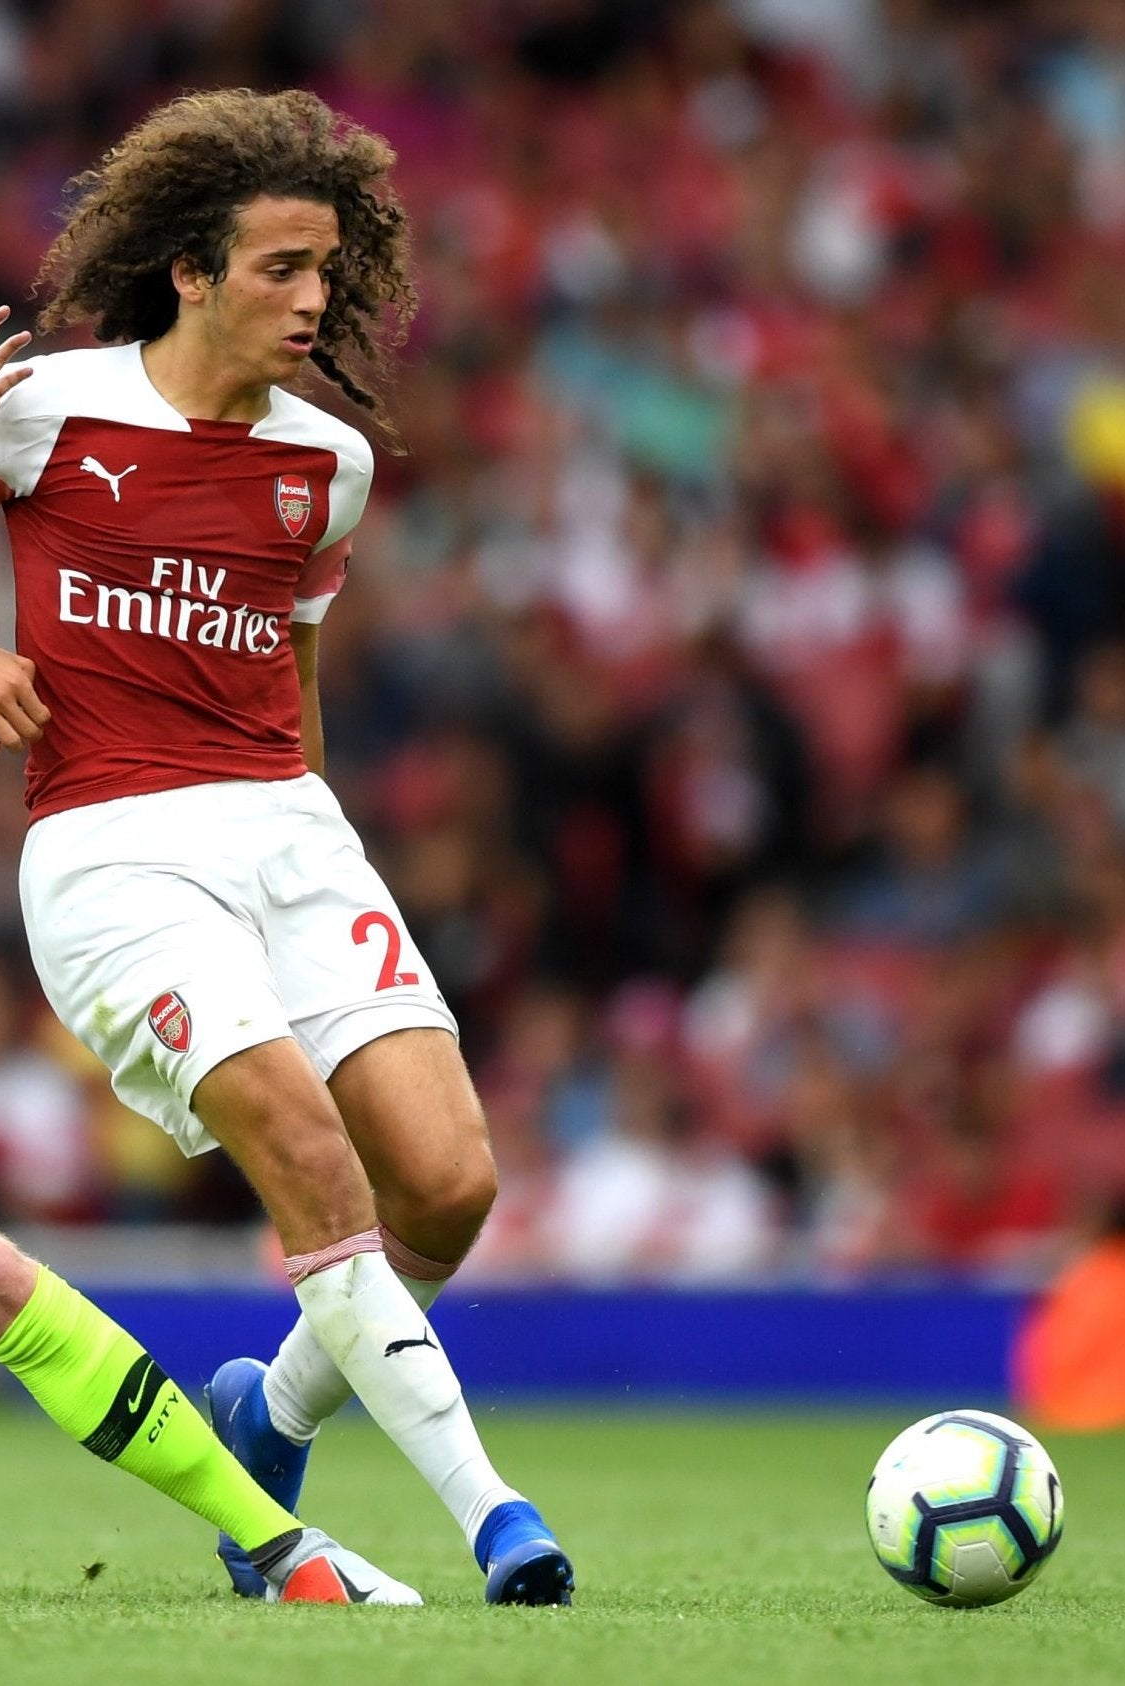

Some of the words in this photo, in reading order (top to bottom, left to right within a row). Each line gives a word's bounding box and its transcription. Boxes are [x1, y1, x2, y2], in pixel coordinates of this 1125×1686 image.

[280, 483, 309, 496] Arsenal
[150, 556, 227, 600] Fly
[58, 568, 280, 655] Emirates
[351, 910, 420, 992] 2
[152, 997, 180, 1026] Arsenal
[148, 1392, 179, 1443] CITY
